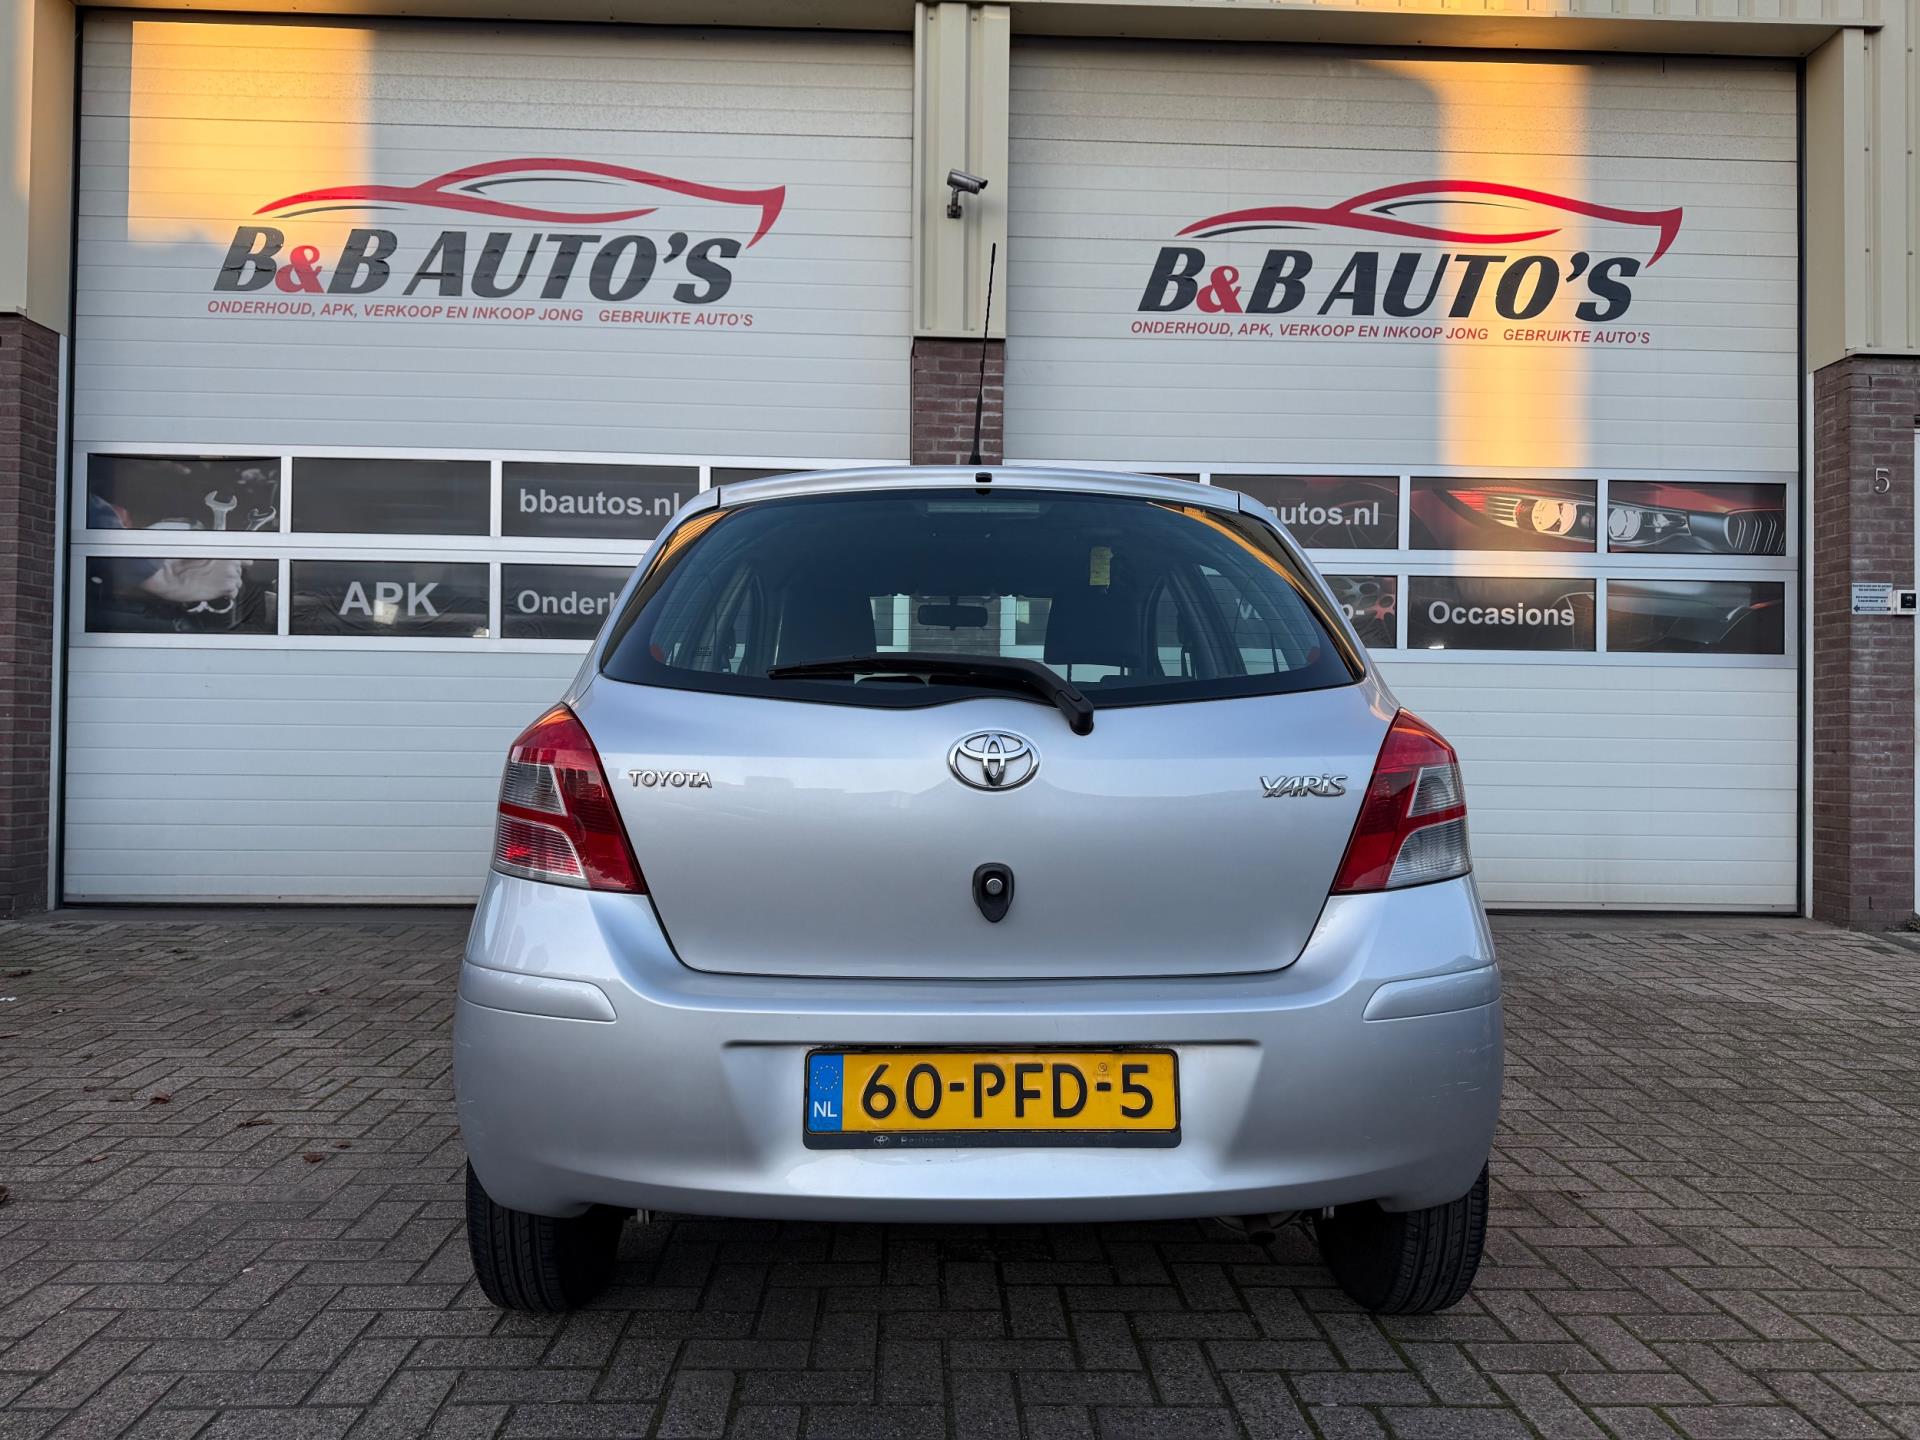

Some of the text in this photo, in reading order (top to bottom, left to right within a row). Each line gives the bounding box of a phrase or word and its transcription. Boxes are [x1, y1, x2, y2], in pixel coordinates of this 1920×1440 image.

[213, 225, 743, 304] B&B AUTO'S
[1137, 247, 1641, 322] B&B AUTO'S
[207, 300, 754, 327] ONDERHOUD, APK, VERKOOP EN INKOOP JONG GEBRUIKTE AUTO'S
[1131, 321, 1651, 344] ONDERHOUD, APK, VERKOOP EN INKOOP JONG GEBRUIKTE AUTO'S
[1874, 468, 1891, 493] 5
[519, 488, 680, 517] bbautos.nl
[338, 581, 440, 617] APK
[1428, 601, 1575, 626] Occasions
[629, 769, 713, 788] TOYOTA
[860, 1062, 1155, 1119] 60-PFD-5
[813, 1100, 838, 1118] NL
